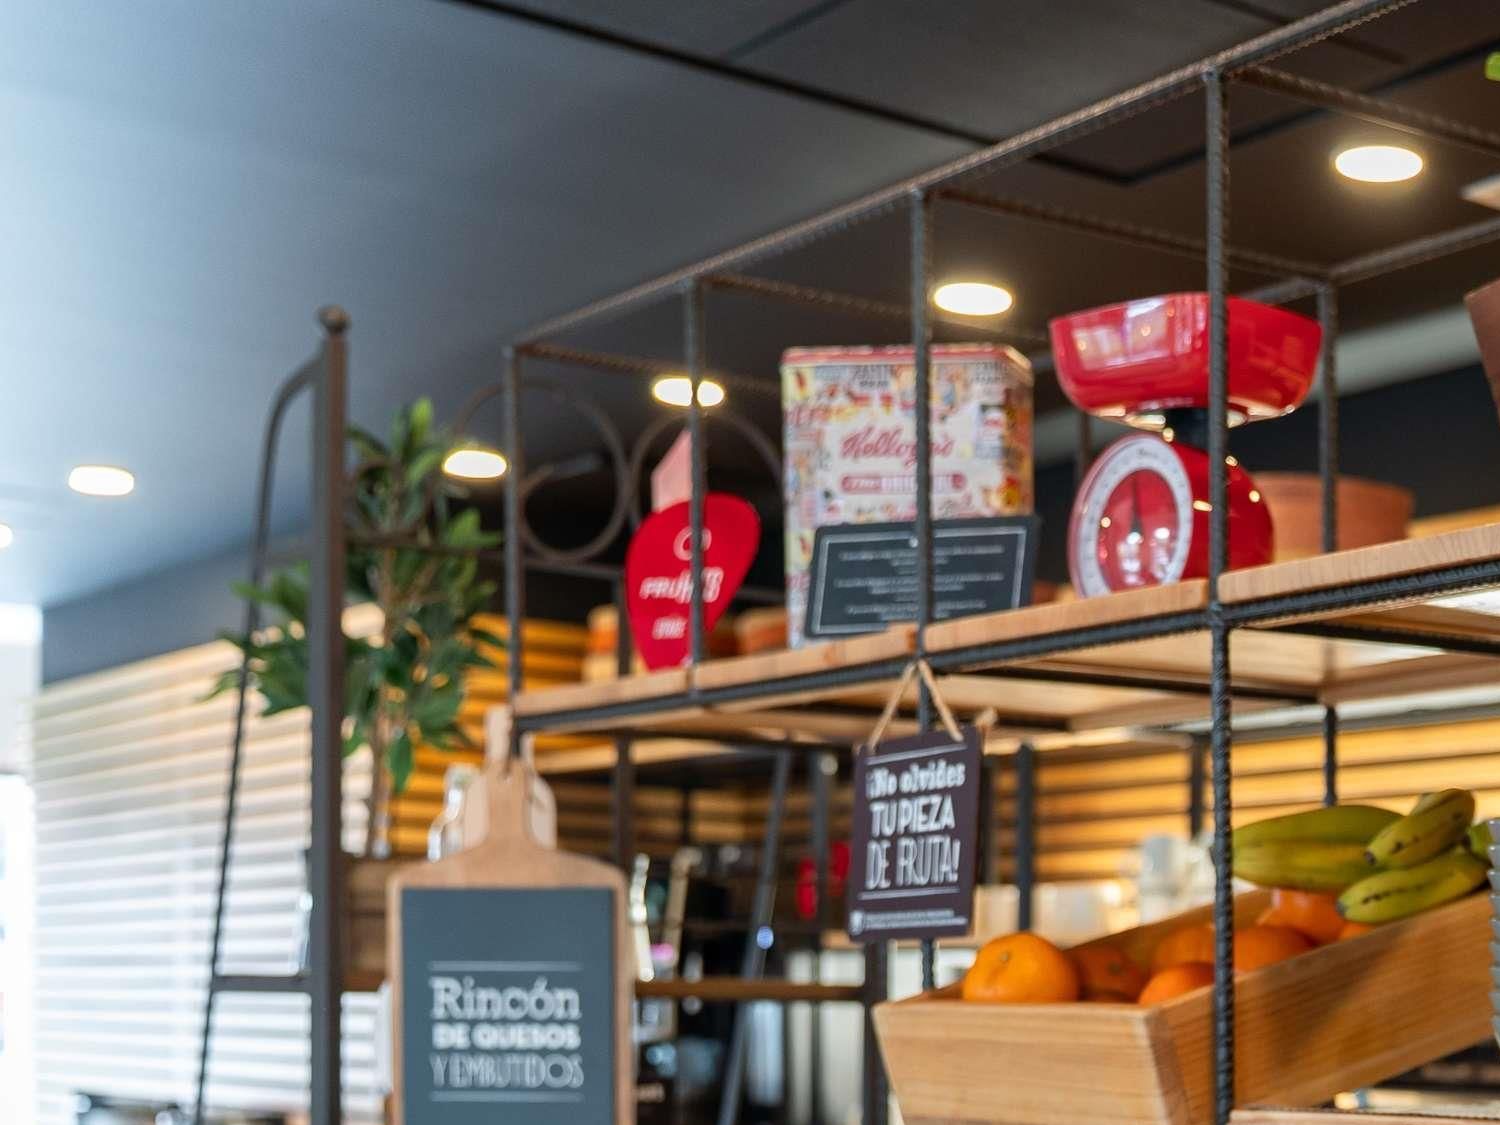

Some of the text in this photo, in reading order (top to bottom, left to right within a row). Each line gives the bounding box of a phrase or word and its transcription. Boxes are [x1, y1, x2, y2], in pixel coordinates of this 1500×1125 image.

[900, 759, 966, 793] olvides
[870, 794, 955, 837] TU PIEZA
[866, 834, 960, 890] DE FRUTA!
[429, 975, 582, 1021] Rincón
[431, 1022, 581, 1050] DE QUESOS
